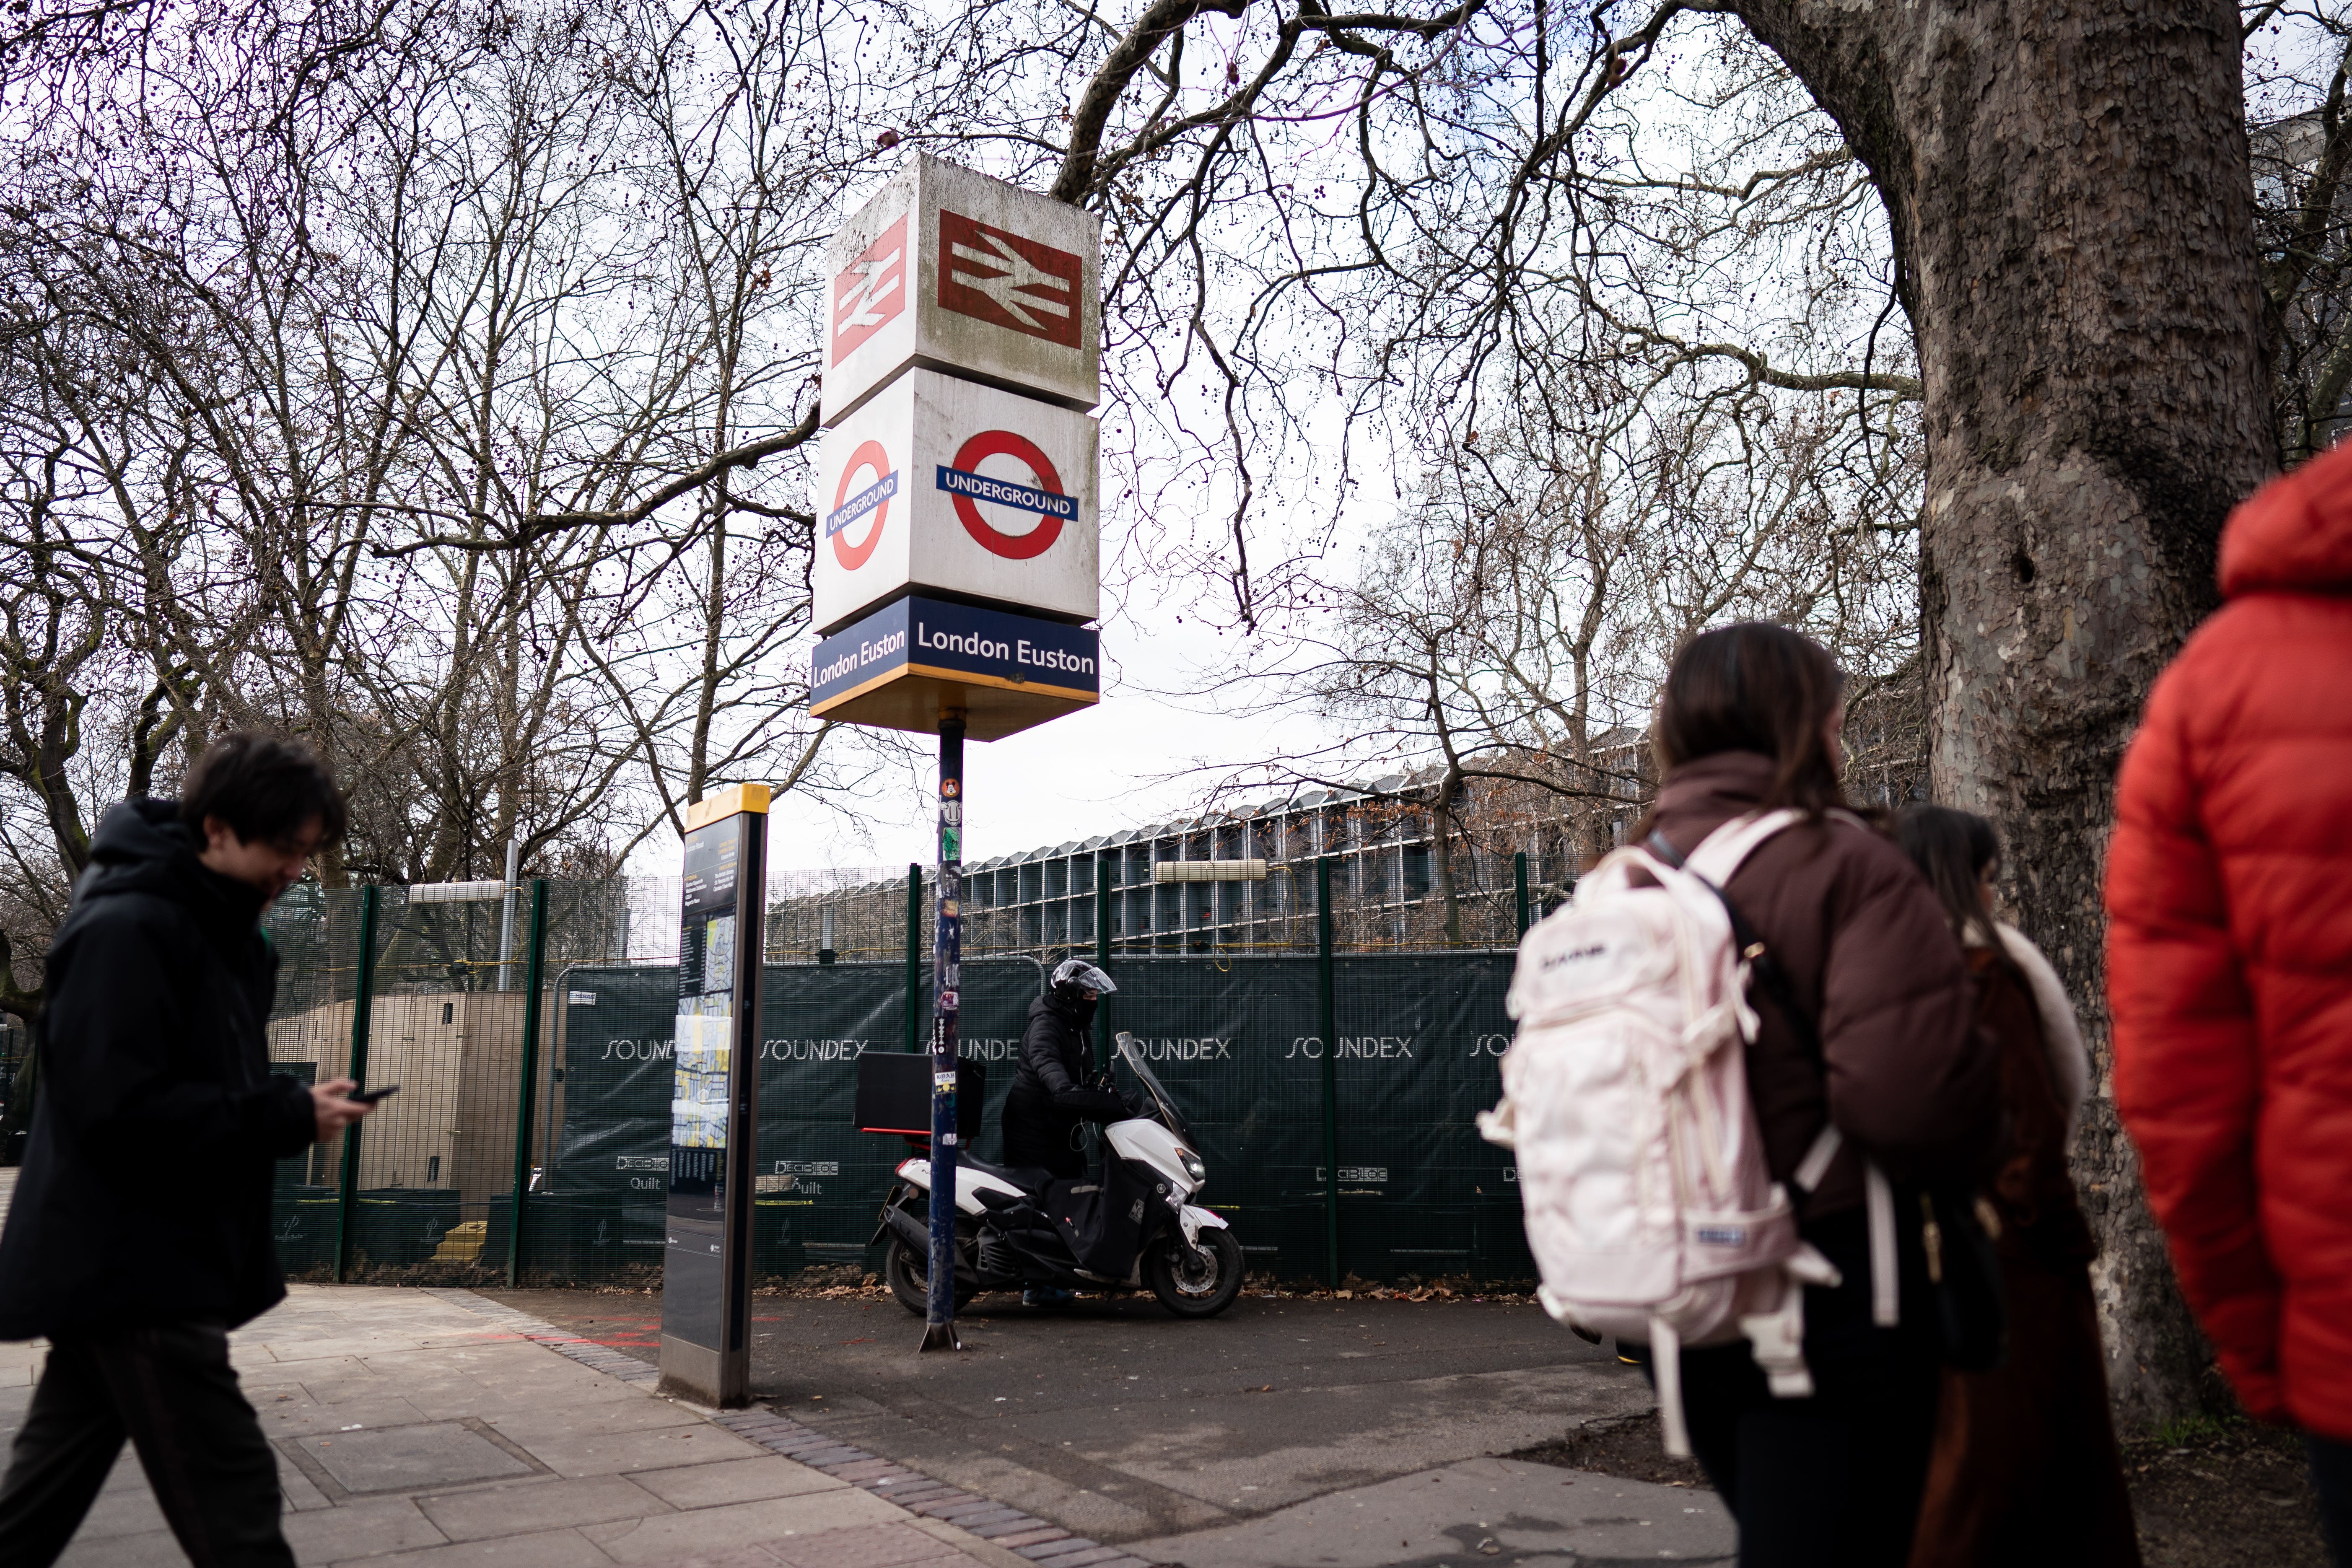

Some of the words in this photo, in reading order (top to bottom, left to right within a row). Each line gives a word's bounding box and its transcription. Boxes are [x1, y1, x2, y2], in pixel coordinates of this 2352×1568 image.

[830, 478, 894, 531] UNDERGROUND
[946, 472, 1070, 514] UNDERGROUND
[813, 653, 858, 689] London
[861, 630, 905, 666] Euston
[918, 622, 1009, 660] London
[1017, 639, 1094, 674] Euston
[760, 1039, 869, 1060] SOUNDEX
[630, 1177, 661, 1190] Quilt
